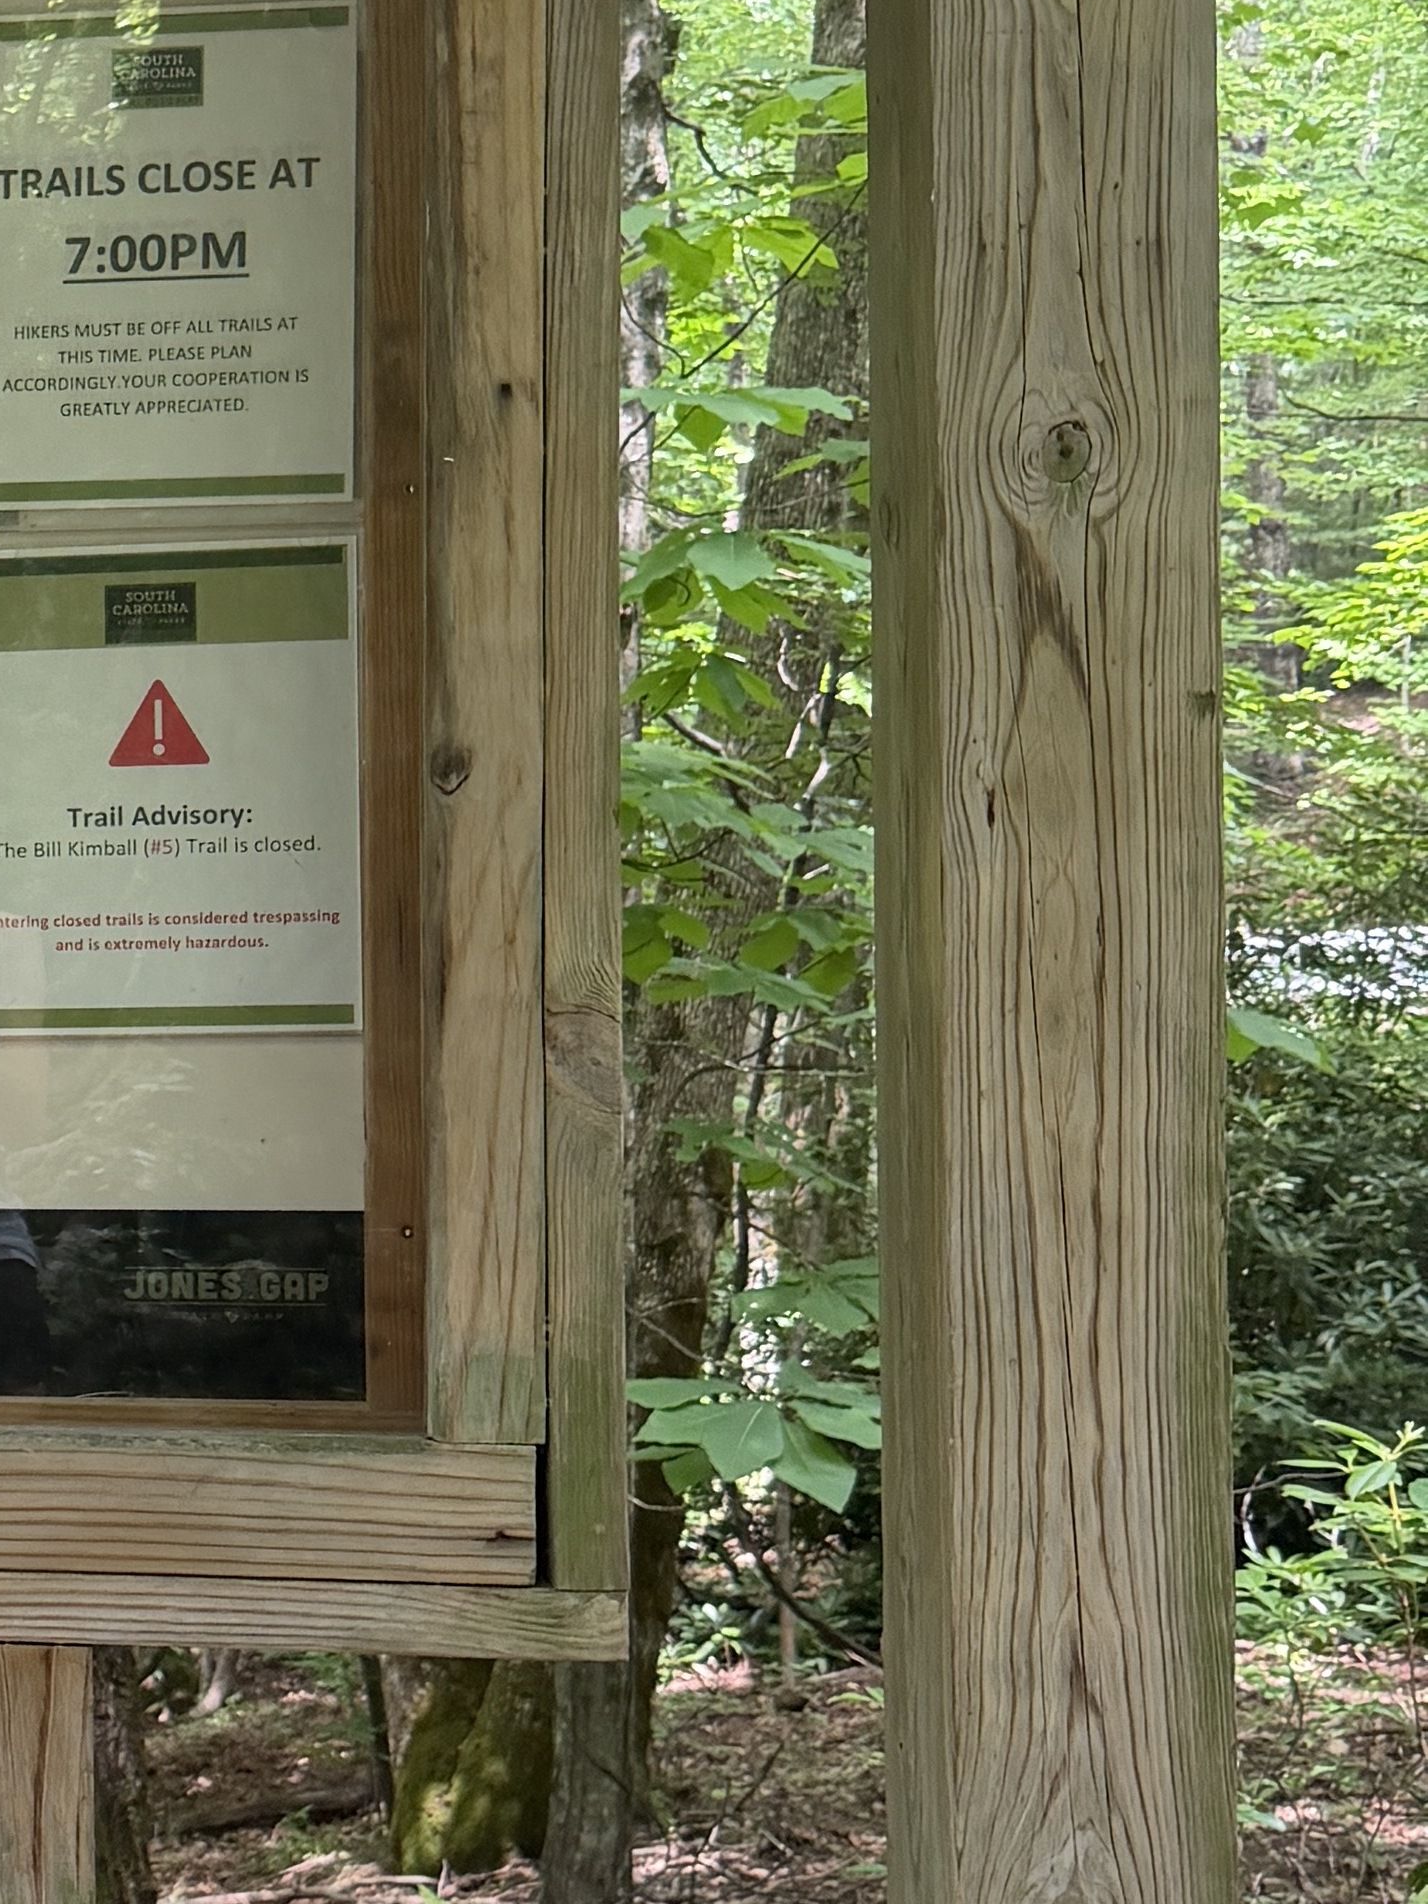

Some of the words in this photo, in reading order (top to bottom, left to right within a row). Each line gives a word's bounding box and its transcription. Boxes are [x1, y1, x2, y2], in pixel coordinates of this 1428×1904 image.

[138, 160, 256, 193] CLOSE
[269, 158, 320, 189] AT
[65, 231, 247, 274] 7:00PM
[15, 325, 69, 339] HIKERS
[75, 323, 121, 337] MUST
[127, 322, 145, 336] BE
[151, 321, 180, 335] OFF
[187, 320, 213, 333] ALL
[219, 318, 272, 332] TRAILS
[277, 317, 298, 330] AT
[58, 350, 93, 364] THIS
[98, 349, 142, 363] TIME.
[149, 347, 204, 361] PLEASE
[211, 345, 251, 359] PLAN
[173, 371, 289, 386] COOPERATION
[296, 369, 309, 383] IS
[60, 401, 130, 417] GREATLY
[135, 398, 249, 414] APPRECIATED.
[126, 590, 175, 602] SOUTH
[113, 603, 188, 615] CAROLINA
[67, 806, 122, 827] Trail
[132, 805, 252, 828] Advisory:
[35, 841, 61, 857] Bill
[69, 839, 136, 856] Kimball
[144, 838, 180, 858] (#5)
[186, 837, 227, 853] Trail
[235, 837, 248, 852] is
[255, 835, 320, 852] closed.
[54, 914, 100, 927] closed
[106, 913, 143, 926] trails
[149, 913, 159, 925] is
[165, 911, 247, 924] considered
[253, 910, 339, 926] trespassing
[56, 939, 83, 951] and
[89, 938, 99, 950] is
[105, 937, 180, 952] extremely
[186, 936, 268, 949] hazardous.
[124, 1271, 242, 1300] JONES
[260, 1271, 328, 1300] GAP
